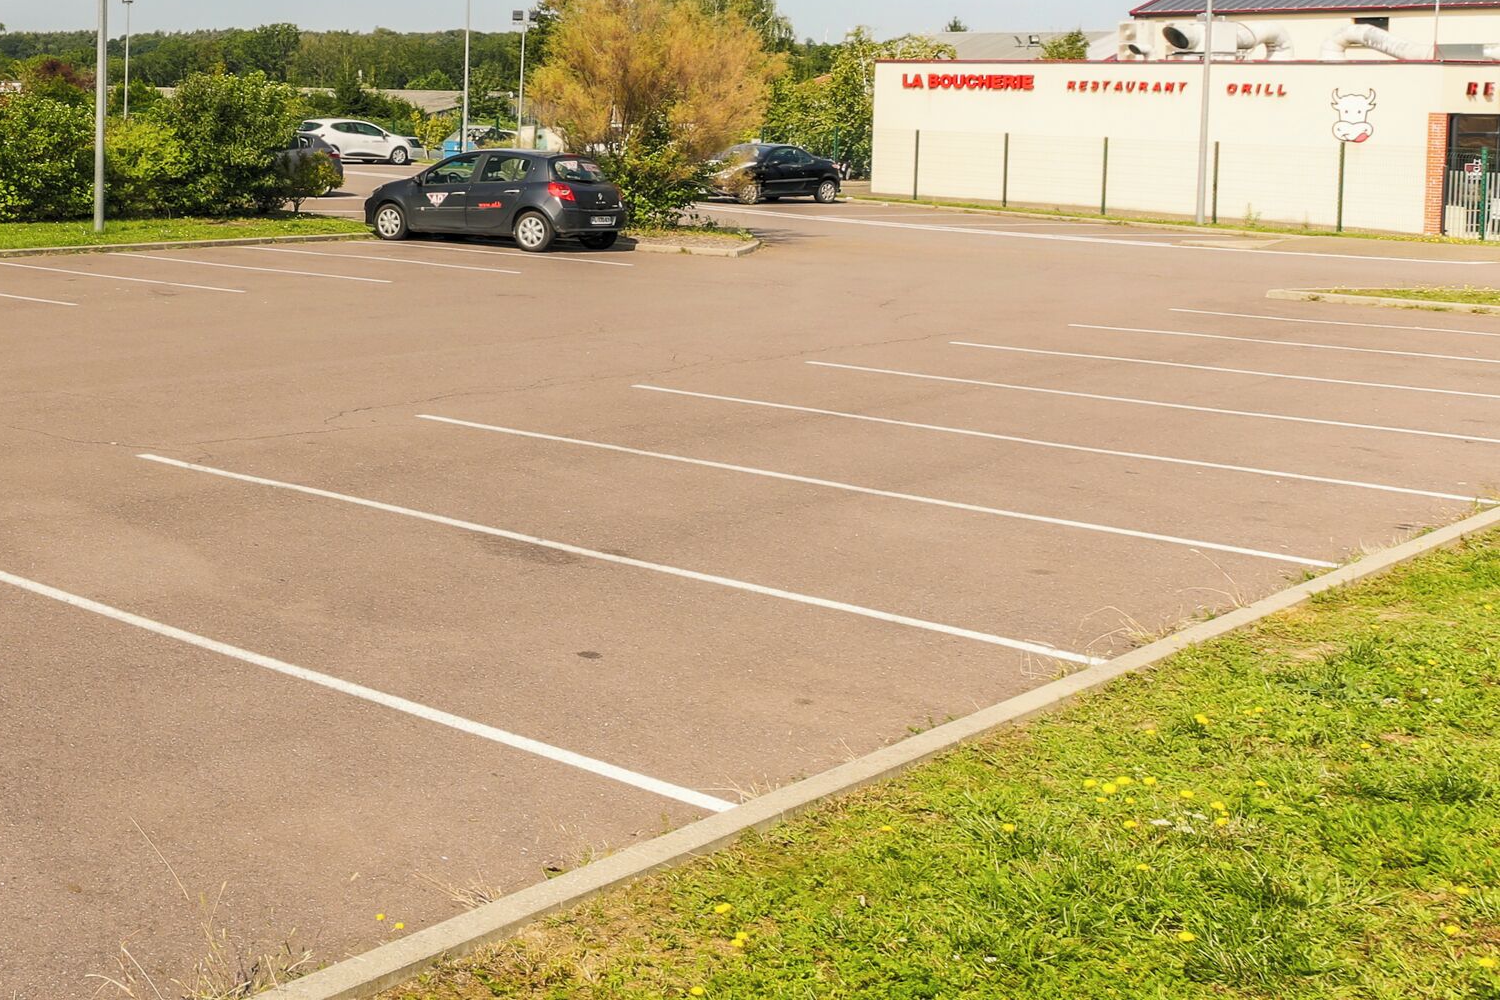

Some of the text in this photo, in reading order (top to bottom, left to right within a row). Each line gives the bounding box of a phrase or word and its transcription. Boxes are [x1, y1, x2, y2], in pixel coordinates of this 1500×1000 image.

[902, 73, 1035, 91] LA BOUCHERIE
[1067, 80, 1287, 97] RESTAURANT GRILL
